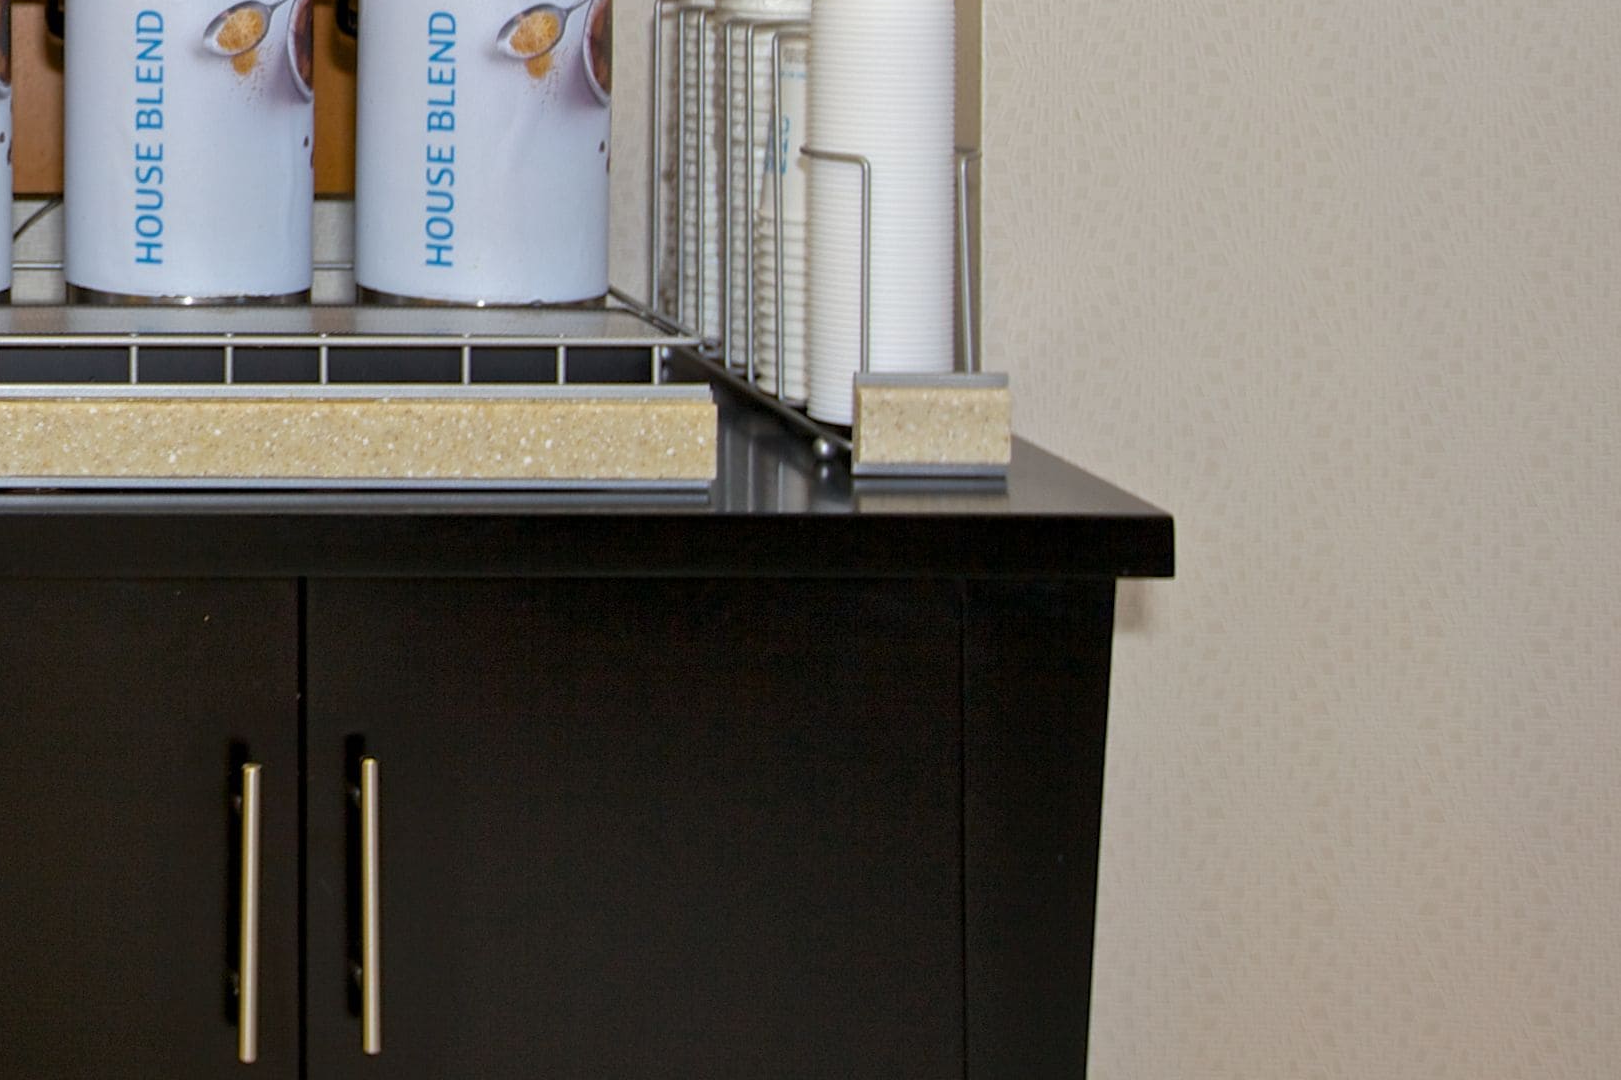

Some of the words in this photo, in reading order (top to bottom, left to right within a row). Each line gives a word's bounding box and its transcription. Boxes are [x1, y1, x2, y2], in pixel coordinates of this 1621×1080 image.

[134, 9, 165, 130] BLEND
[425, 11, 457, 132] BLEND
[134, 143, 165, 265] HOUSE
[425, 145, 456, 268] HOUSE
